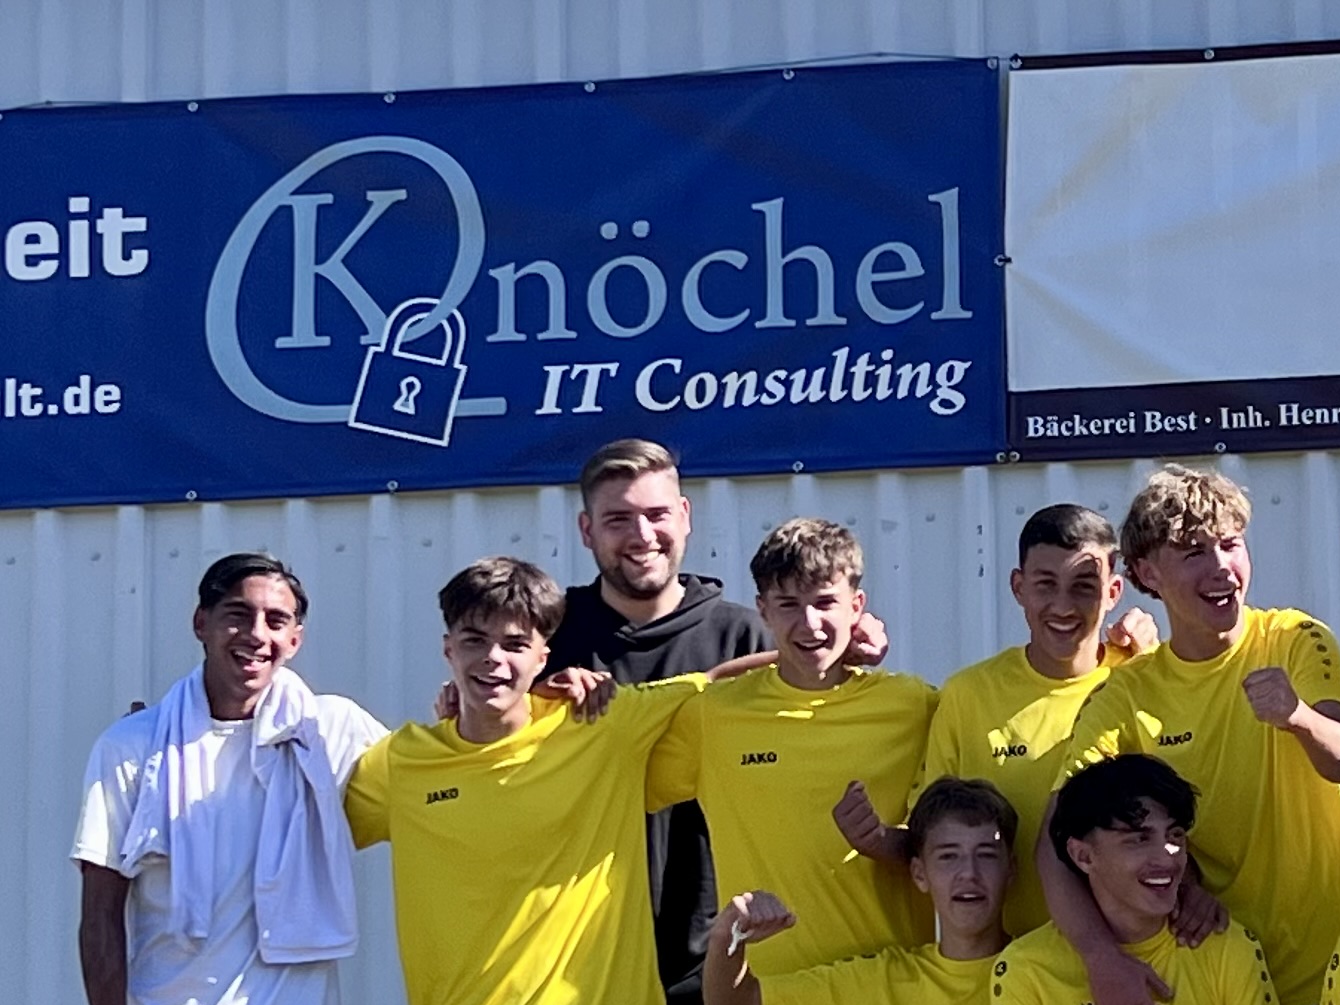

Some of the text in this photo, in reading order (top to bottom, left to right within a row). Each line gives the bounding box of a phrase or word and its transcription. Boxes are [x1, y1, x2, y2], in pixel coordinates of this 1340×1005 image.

[5, 196, 149, 281] eit
[535, 346, 972, 415] IT Consulting
[1026, 411, 1136, 438] Bäckerei
[1144, 410, 1198, 434] Best
[1219, 406, 1271, 430] Inh.
[1158, 732, 1192, 746] JAKO
[741, 751, 778, 765] JAKO
[992, 745, 1028, 757] JAKO
[426, 788, 459, 804] JAKO
